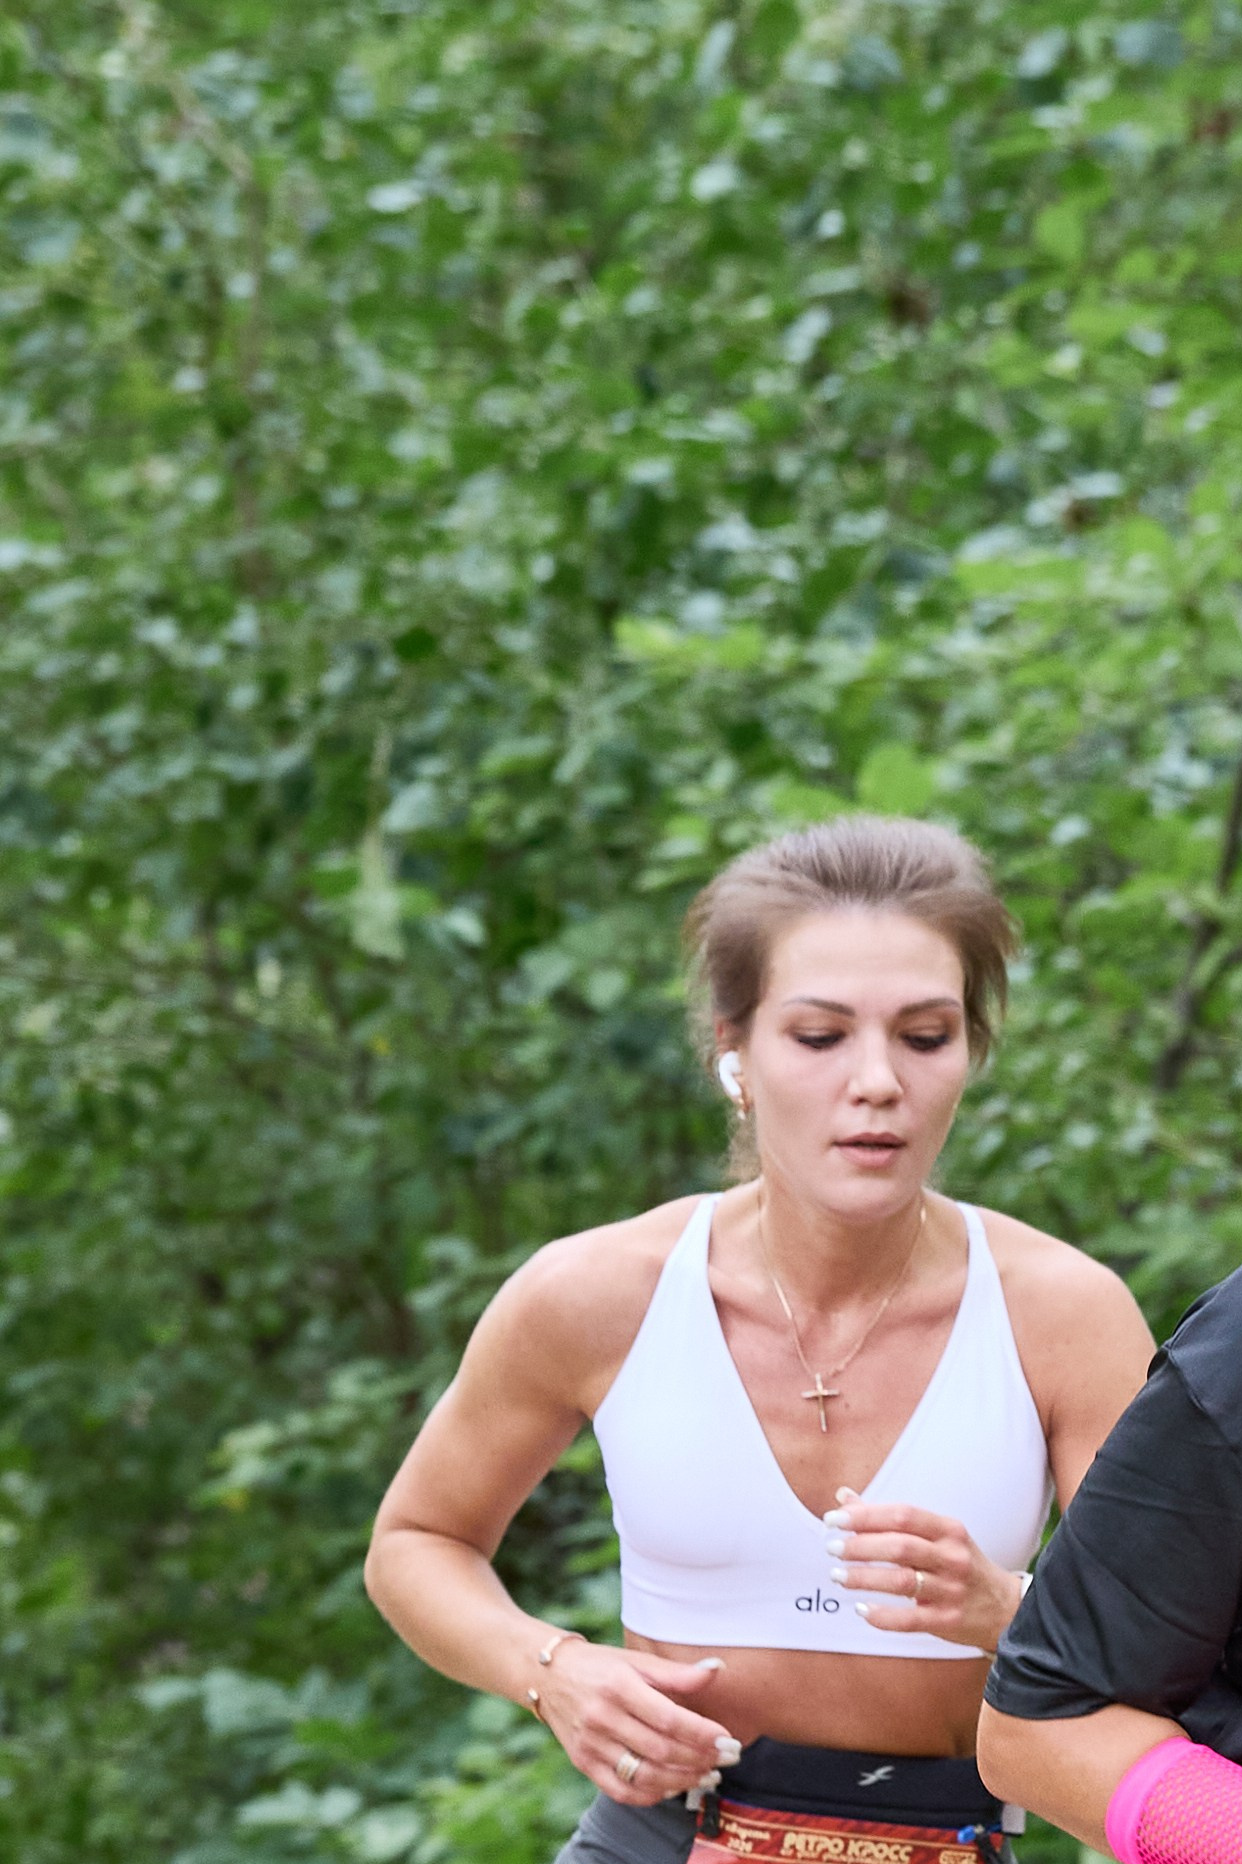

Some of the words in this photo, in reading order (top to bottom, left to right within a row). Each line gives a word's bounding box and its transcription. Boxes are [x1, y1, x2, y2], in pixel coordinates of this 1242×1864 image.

[795, 1587, 840, 1614] alo
[783, 1832, 844, 1855] РЕТРО
[847, 1840, 914, 1864] КРОСС
